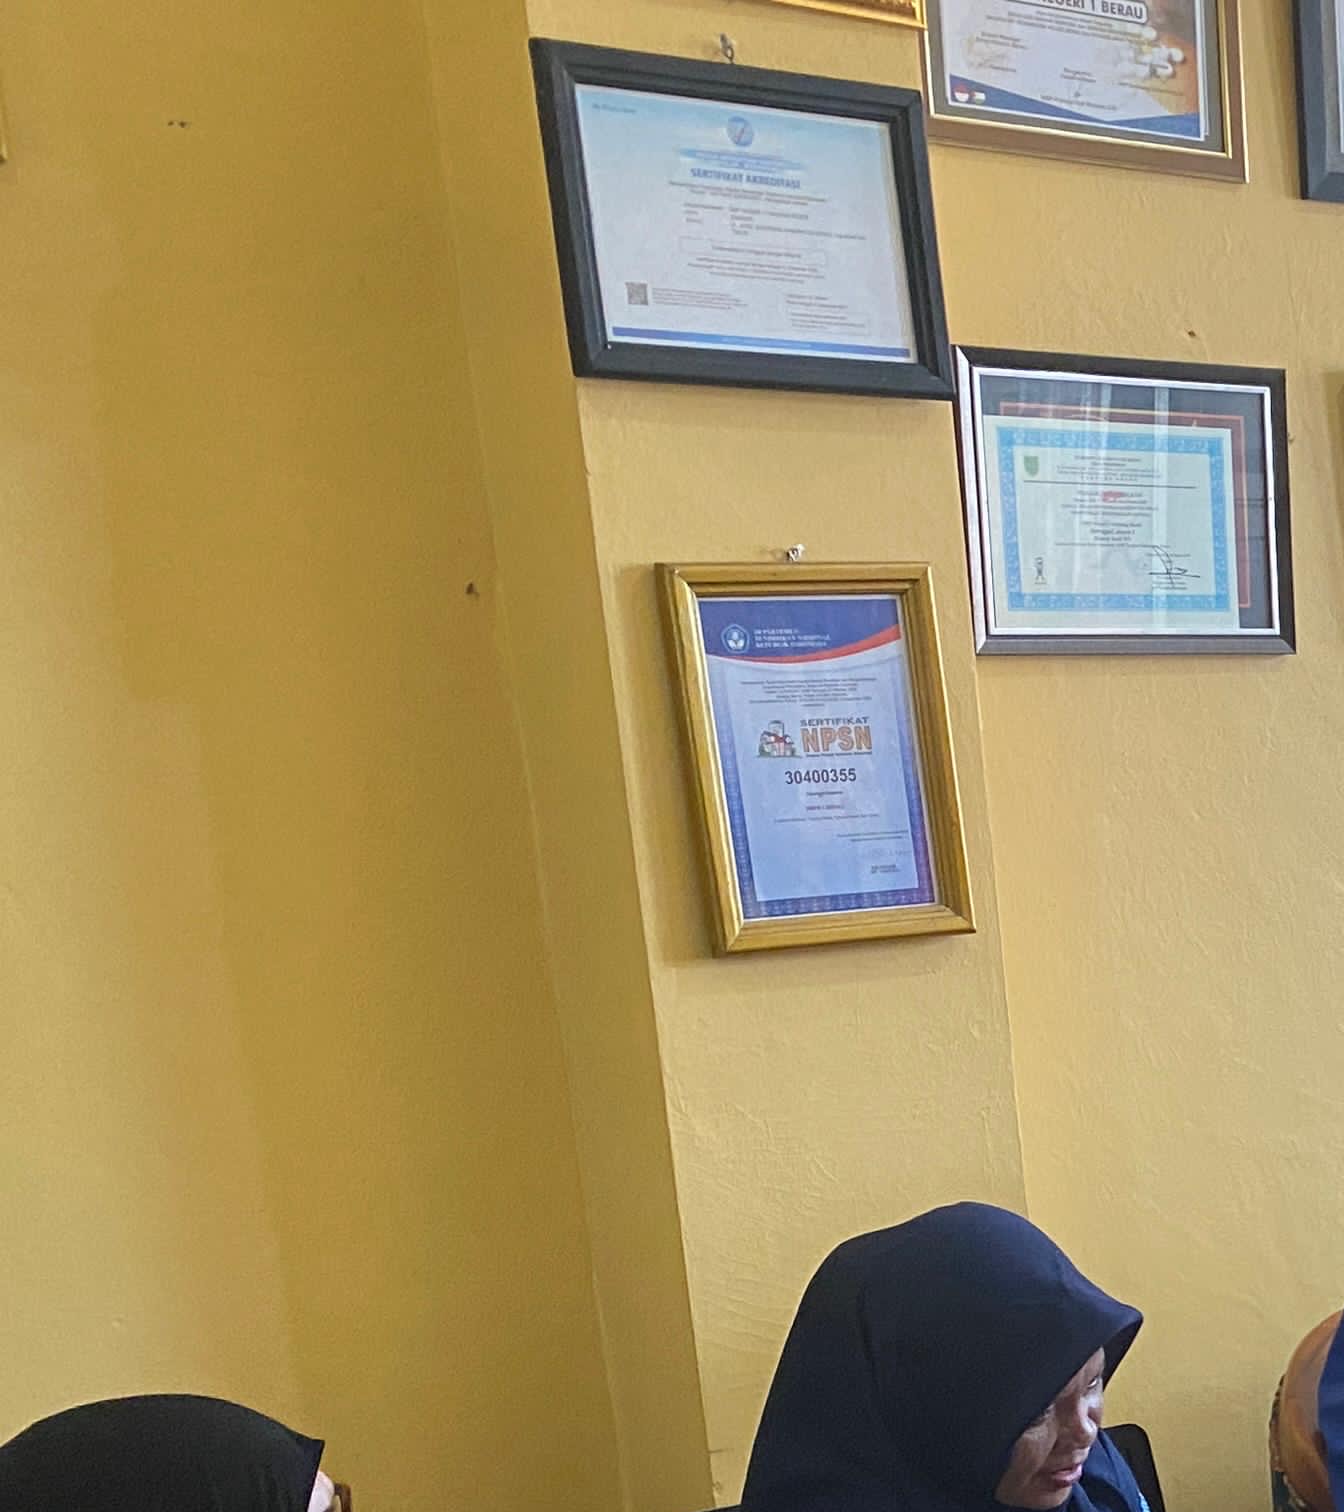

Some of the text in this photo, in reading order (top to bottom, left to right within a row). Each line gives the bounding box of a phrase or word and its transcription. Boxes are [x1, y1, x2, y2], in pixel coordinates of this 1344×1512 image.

[1101, 1, 1143, 19] BERAU
[800, 716, 870, 727] SERTIFIKAT
[800, 725, 873, 753] NPSN
[785, 768, 857, 785] 30400355
